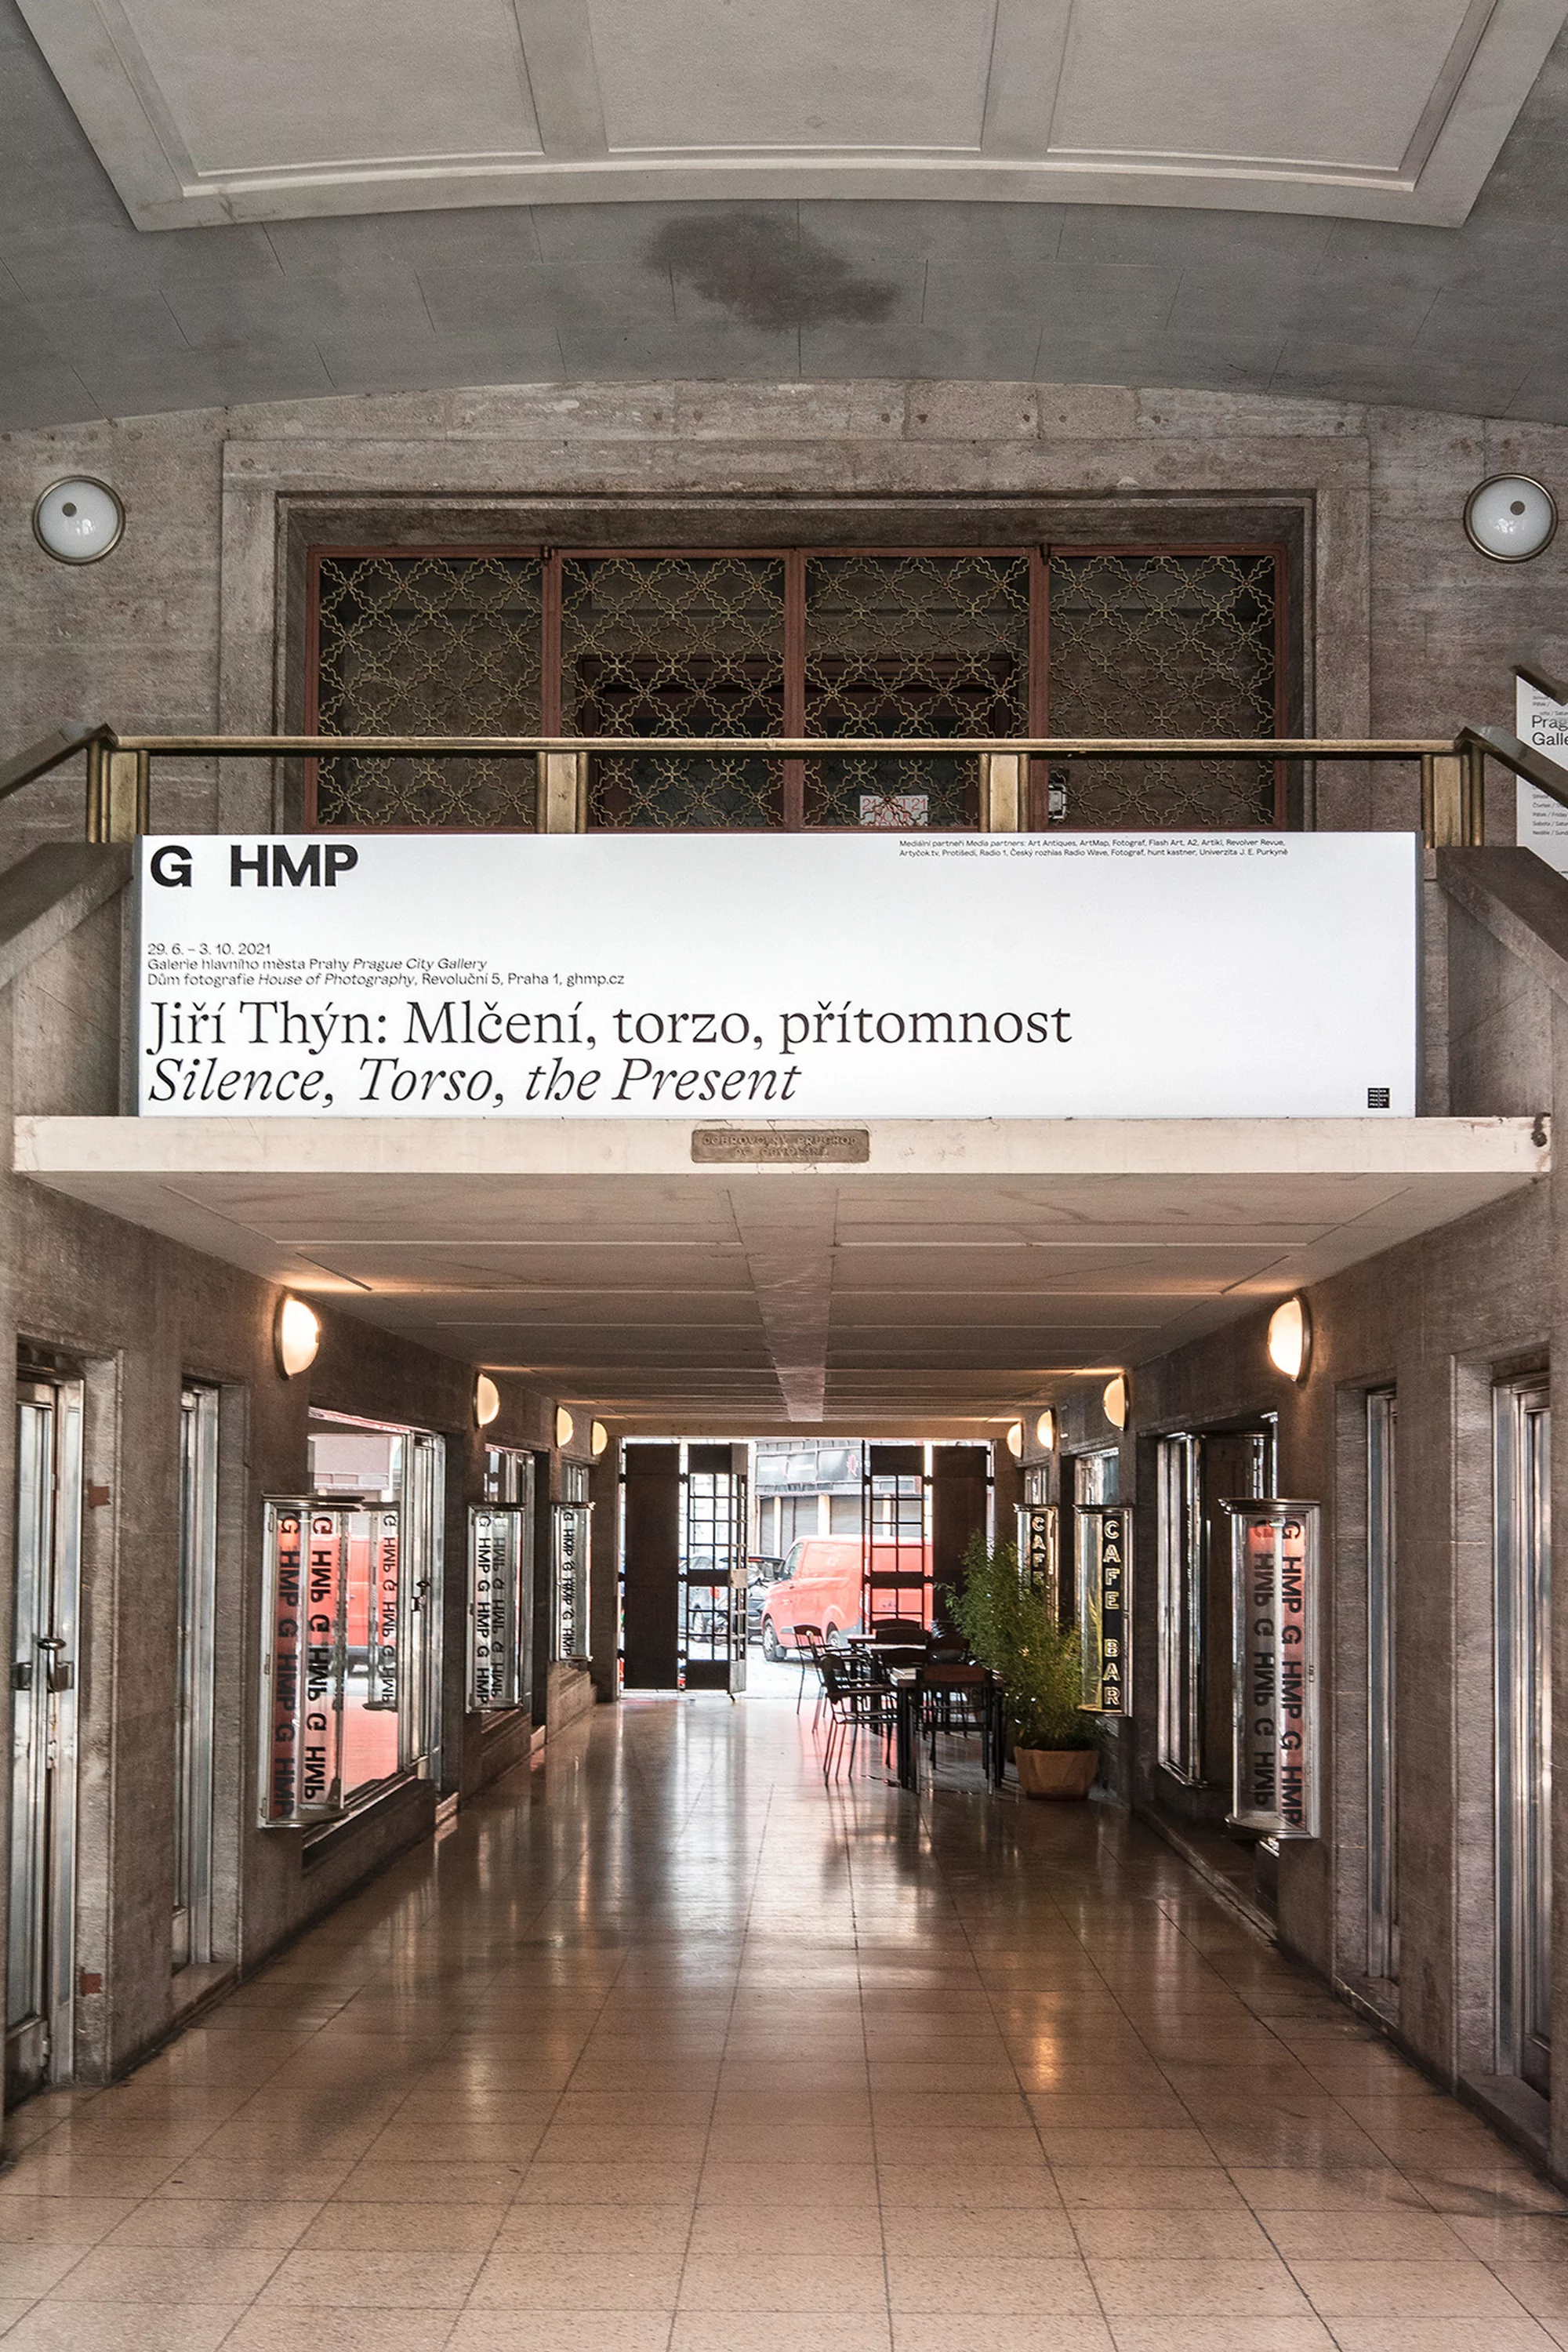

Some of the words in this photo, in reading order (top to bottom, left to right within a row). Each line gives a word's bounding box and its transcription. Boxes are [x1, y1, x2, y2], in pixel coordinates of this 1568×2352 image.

[979, 848, 1001, 857] Radio
[1010, 848, 1033, 857] Český
[1035, 848, 1062, 857] rozhlas
[1064, 848, 1086, 857] Radio
[1147, 848, 1165, 857] hunt
[1199, 848, 1238, 857] Univerzita
[1256, 848, 1288, 857] Purkyně
[1149, 839, 1169, 848] Flash
[1225, 839, 1259, 848] Revolver
[151, 845, 192, 887] G
[230, 844, 358, 887] HMP
[147, 942, 169, 955] 29.
[172, 942, 184, 955] 6.
[199, 942, 212, 955] 3.
[216, 942, 234, 955] 10.
[238, 942, 270, 955] 2021
[147, 958, 198, 970] Galerie
[201, 958, 260, 970] hlavního
[263, 959, 306, 970] města
[310, 958, 350, 972] Prahy
[353, 958, 403, 972] Prague
[406, 958, 434, 972] City
[437, 957, 488, 972] Gallery
[147, 973, 180, 985] Dům
[183, 973, 255, 988] fotografie
[258, 974, 303, 985] House
[305, 972, 321, 985] of
[325, 973, 418, 988] Photography,
[422, 972, 488, 985] Revoluční
[492, 972, 504, 987] 5,
[508, 972, 549, 985] Praha
[552, 973, 562, 987] 1,
[566, 972, 625, 988] ghmp.cz
[147, 1001, 225, 1056] Jiří
[240, 1000, 385, 1055] Thýn:
[404, 1000, 596, 1050] Mlčení,
[613, 1008, 762, 1050] torzo,
[780, 1000, 1073, 1054] přítomnost
[148, 1057, 333, 1109] Silence,
[360, 1057, 503, 1109] Torso,
[526, 1056, 601, 1101] the
[612, 1057, 802, 1101] Present
[281, 1517, 299, 1534] G
[478, 1515, 491, 1527] G
[477, 1537, 491, 1573] HMP
[1103, 1519, 1121, 1610] CAFE
[278, 1551, 300, 1607] HMP
[477, 1579, 490, 1592] G
[1280, 1556, 1302, 1613] HMP
[278, 1619, 298, 1638] G
[477, 1602, 490, 1639] HMP
[1281, 1624, 1302, 1645] G
[476, 1645, 490, 1658] G
[277, 1654, 298, 1711] HMP
[1102, 1638, 1121, 1706] BAR
[476, 1668, 490, 1704] HMP
[1280, 1661, 1302, 1719] HMP
[275, 1723, 295, 1743] G
[1281, 1730, 1302, 1750] G
